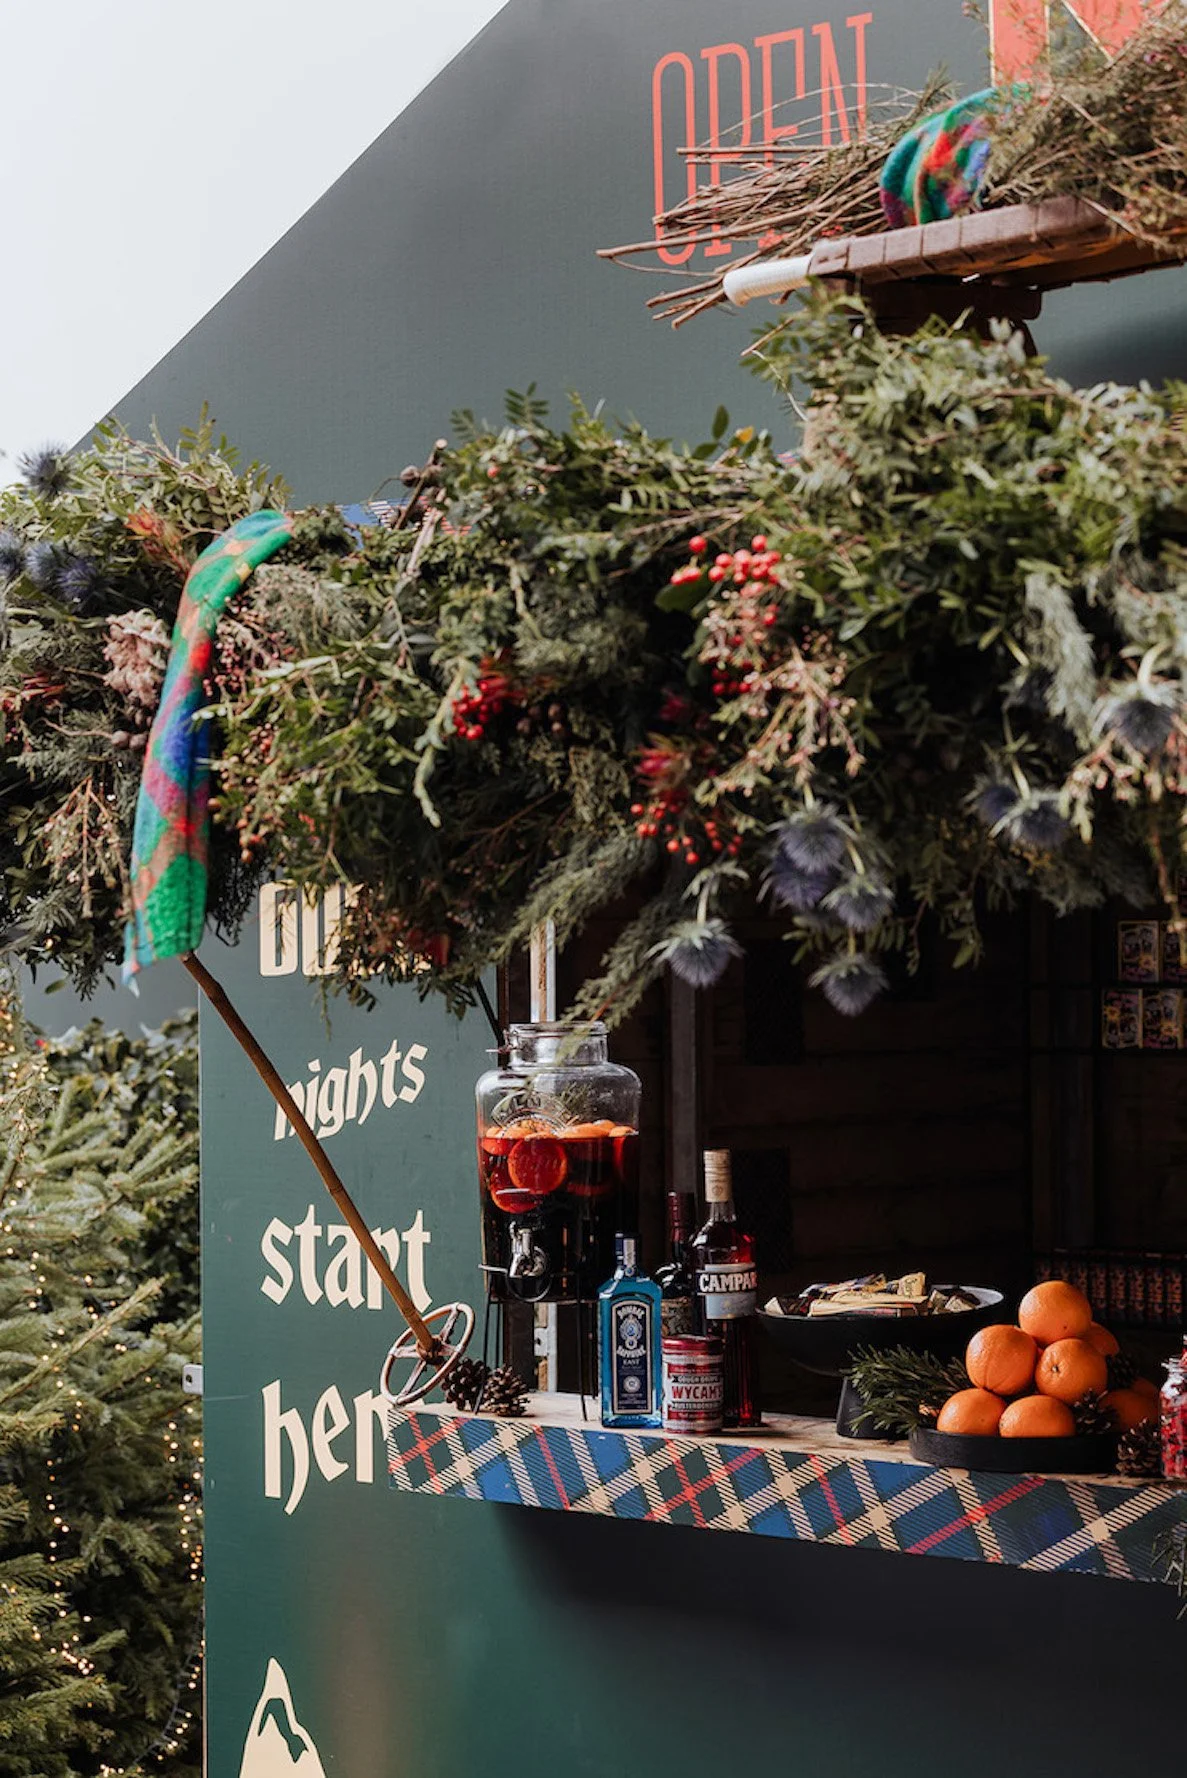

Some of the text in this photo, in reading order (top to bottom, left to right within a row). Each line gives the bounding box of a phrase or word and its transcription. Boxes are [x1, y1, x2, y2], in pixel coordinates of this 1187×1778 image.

[273, 1039, 429, 1141] nights
[260, 1204, 432, 1313] start
[261, 1379, 393, 1515] her
